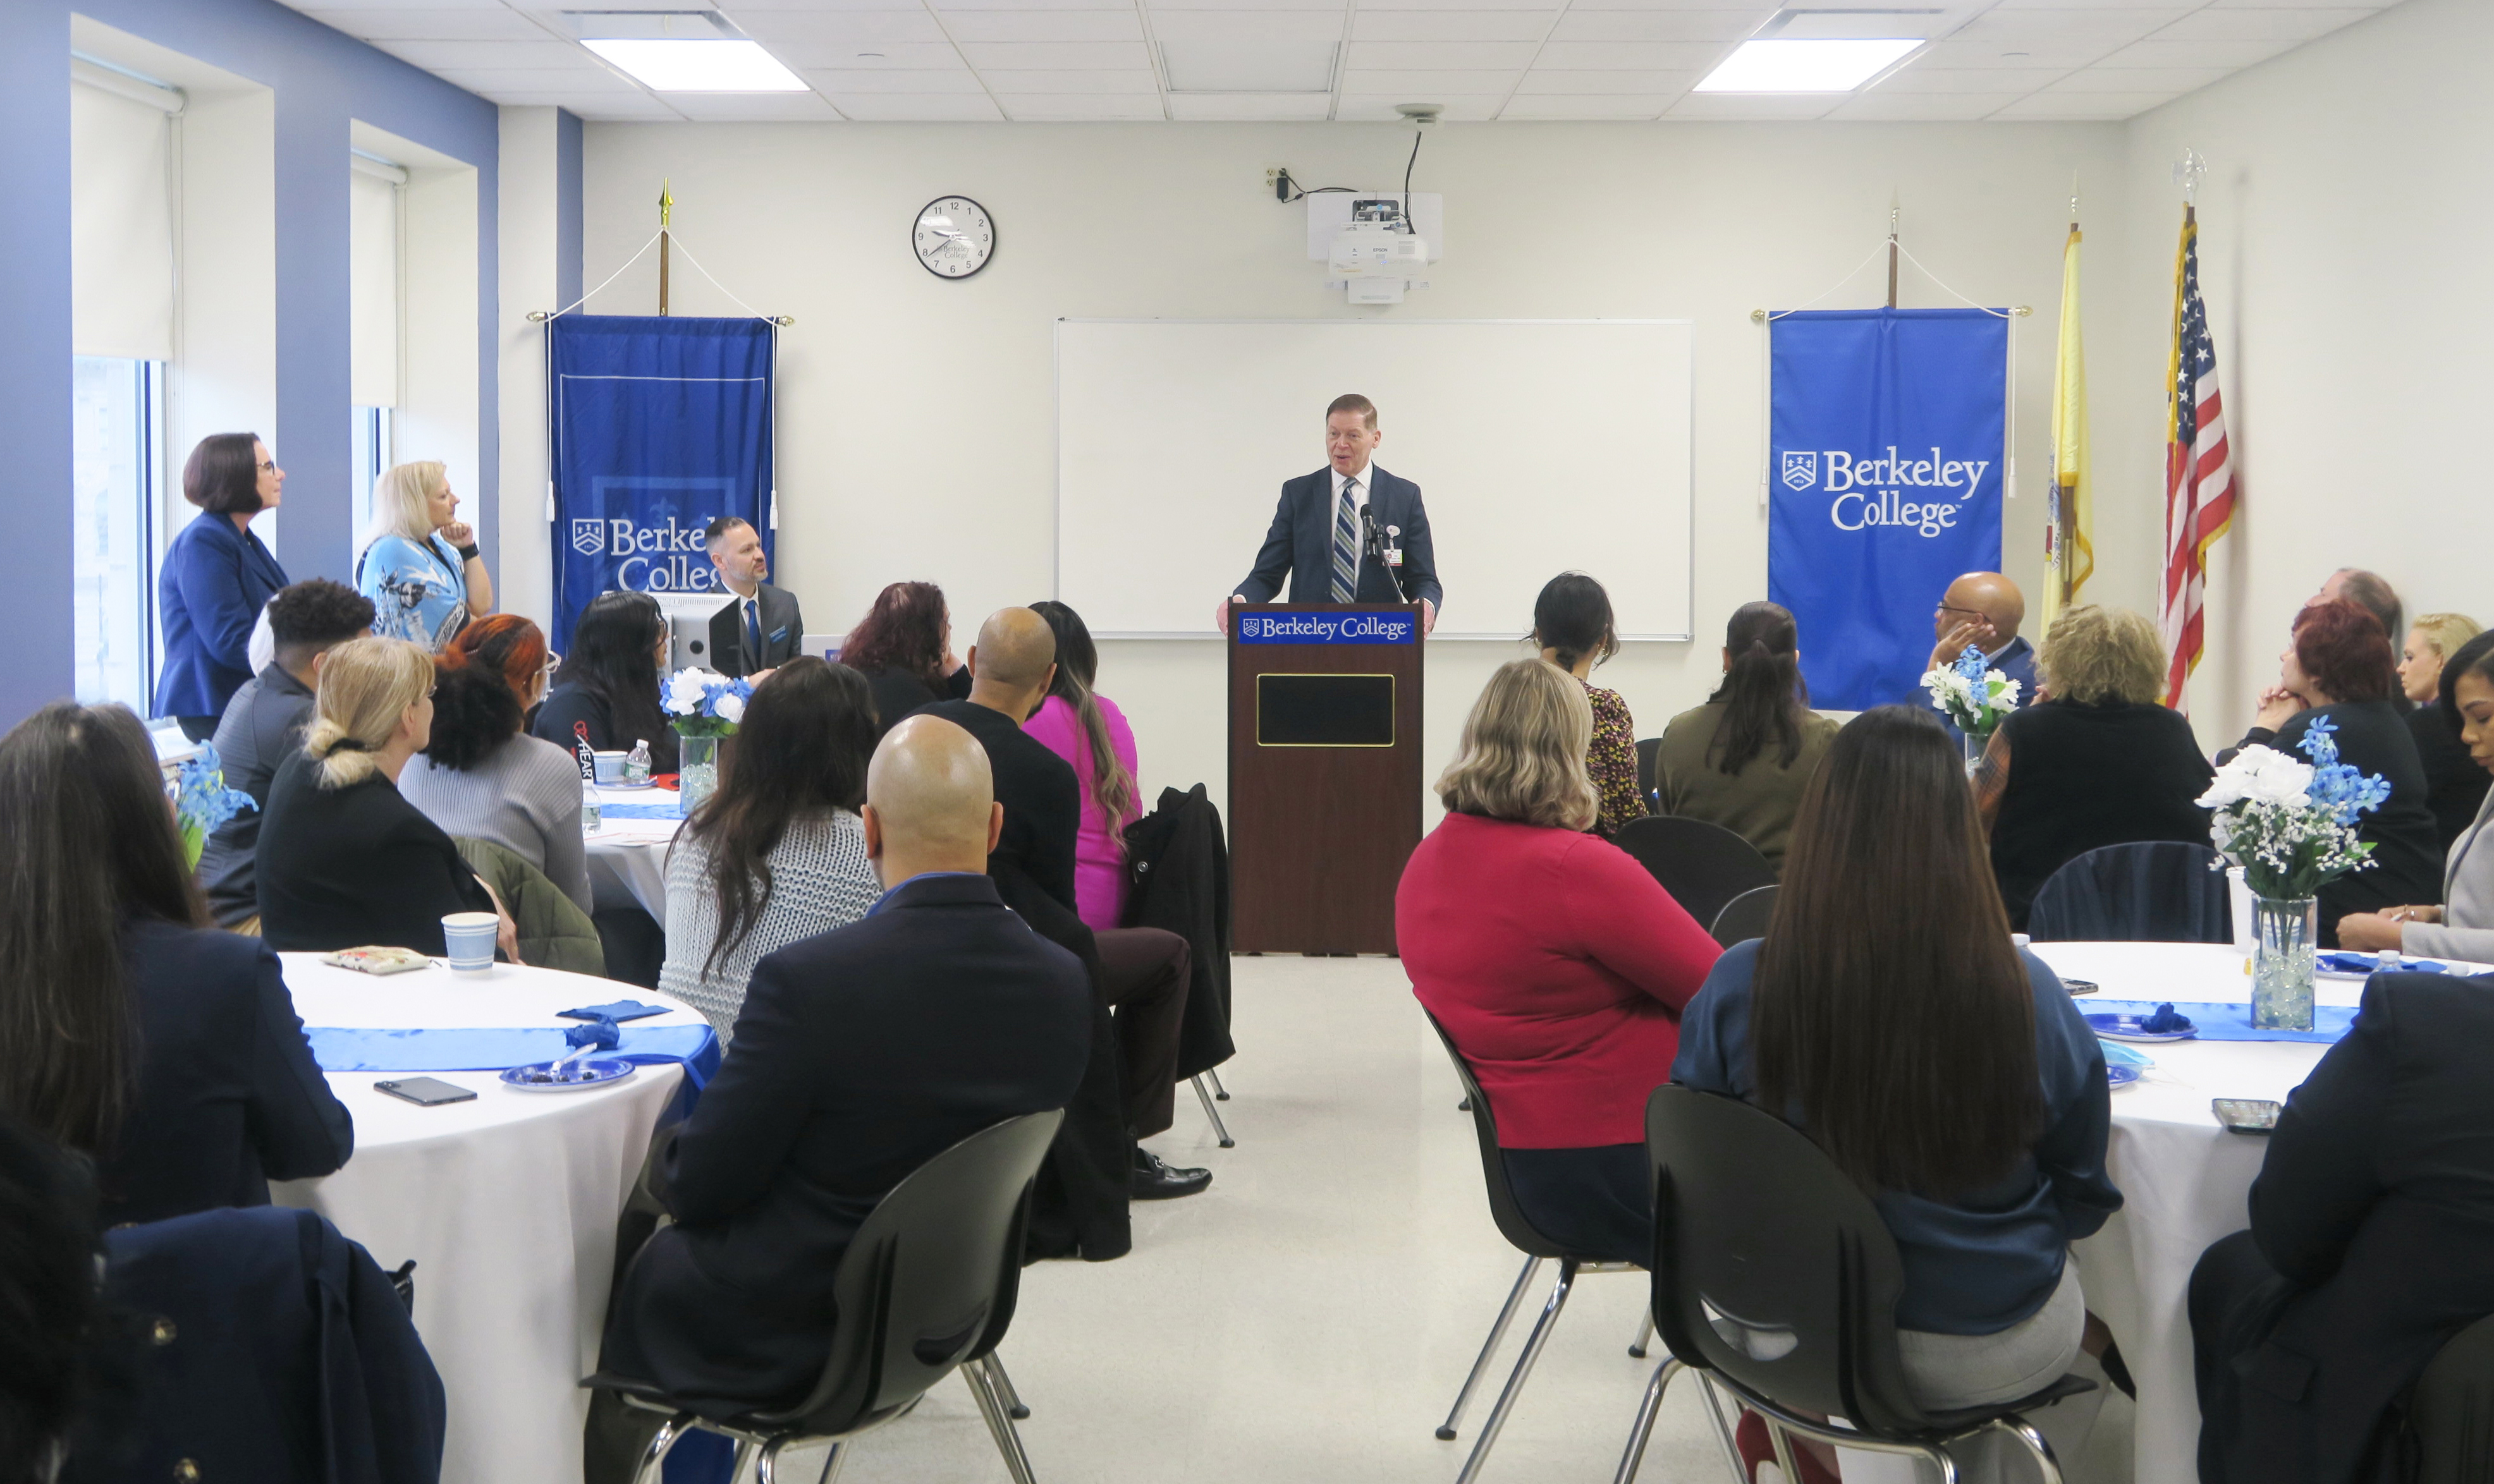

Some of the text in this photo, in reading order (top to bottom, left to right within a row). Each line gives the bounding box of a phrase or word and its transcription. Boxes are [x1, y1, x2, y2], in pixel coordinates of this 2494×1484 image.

[950, 202, 959, 210] 12
[934, 207, 942, 215] 11
[979, 219, 984, 227] 2
[922, 248, 928, 257] 8
[943, 245, 970, 253] Berkeley
[944, 251, 969, 260] College
[950, 265, 955, 273] 6
[966, 260, 972, 269] 5
[1823, 446, 1990, 500] Berkeley
[1831, 490, 1957, 538] College
[609, 516, 716, 556] Berke
[618, 556, 718, 592] Colle
[1262, 617, 1407, 640] Berkeley College
